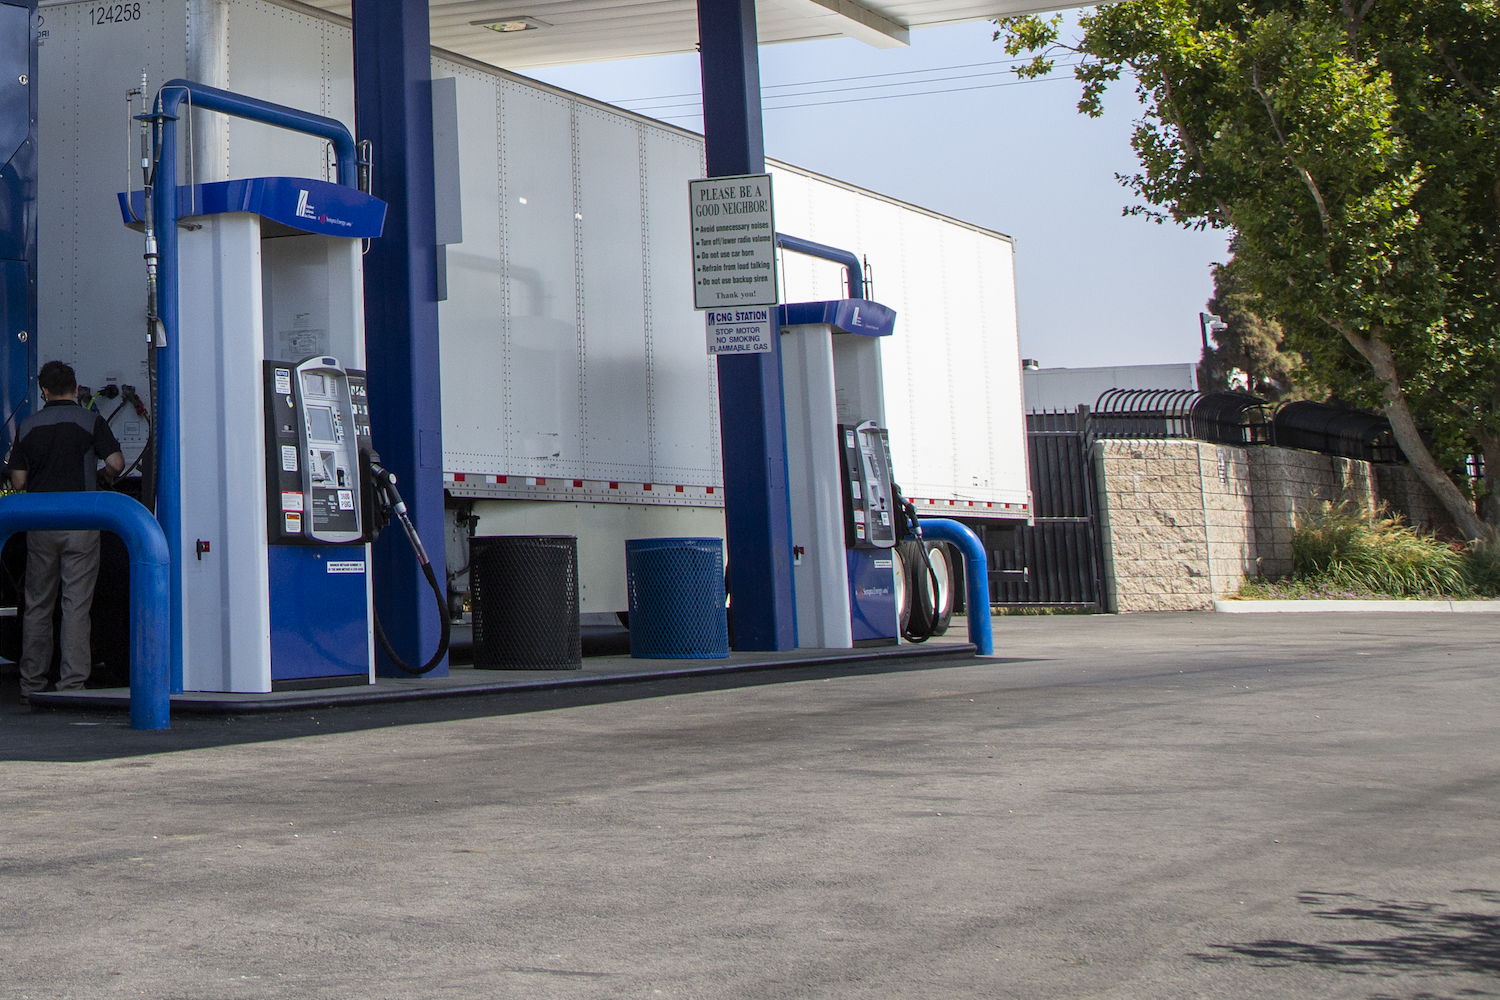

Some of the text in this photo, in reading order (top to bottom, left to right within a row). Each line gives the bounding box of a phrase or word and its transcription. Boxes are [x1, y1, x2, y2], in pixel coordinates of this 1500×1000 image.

[89, 2, 141, 26] 124258
[700, 185, 762, 201] PLEASE BE A
[696, 200, 768, 217] GOOD NEIGHBOR!
[700, 225, 715, 233] Avoid
[716, 223, 750, 231] unnecessary
[701, 238, 712, 246] Turn
[738, 235, 751, 243] radio
[710, 251, 719, 259] not
[741, 249, 754, 257] horn
[702, 261, 770, 272] Refrain from loud talking
[711, 277, 720, 285] not
[732, 276, 752, 284] backup
[754, 274, 768, 282] siren
[716, 290, 757, 299] Thank you!
[716, 311, 767, 322] CNG STATION
[736, 326, 760, 334] MOTOR
[728, 335, 760, 343] SMOKING
[709, 343, 768, 352] FLAMMABLE GAS
